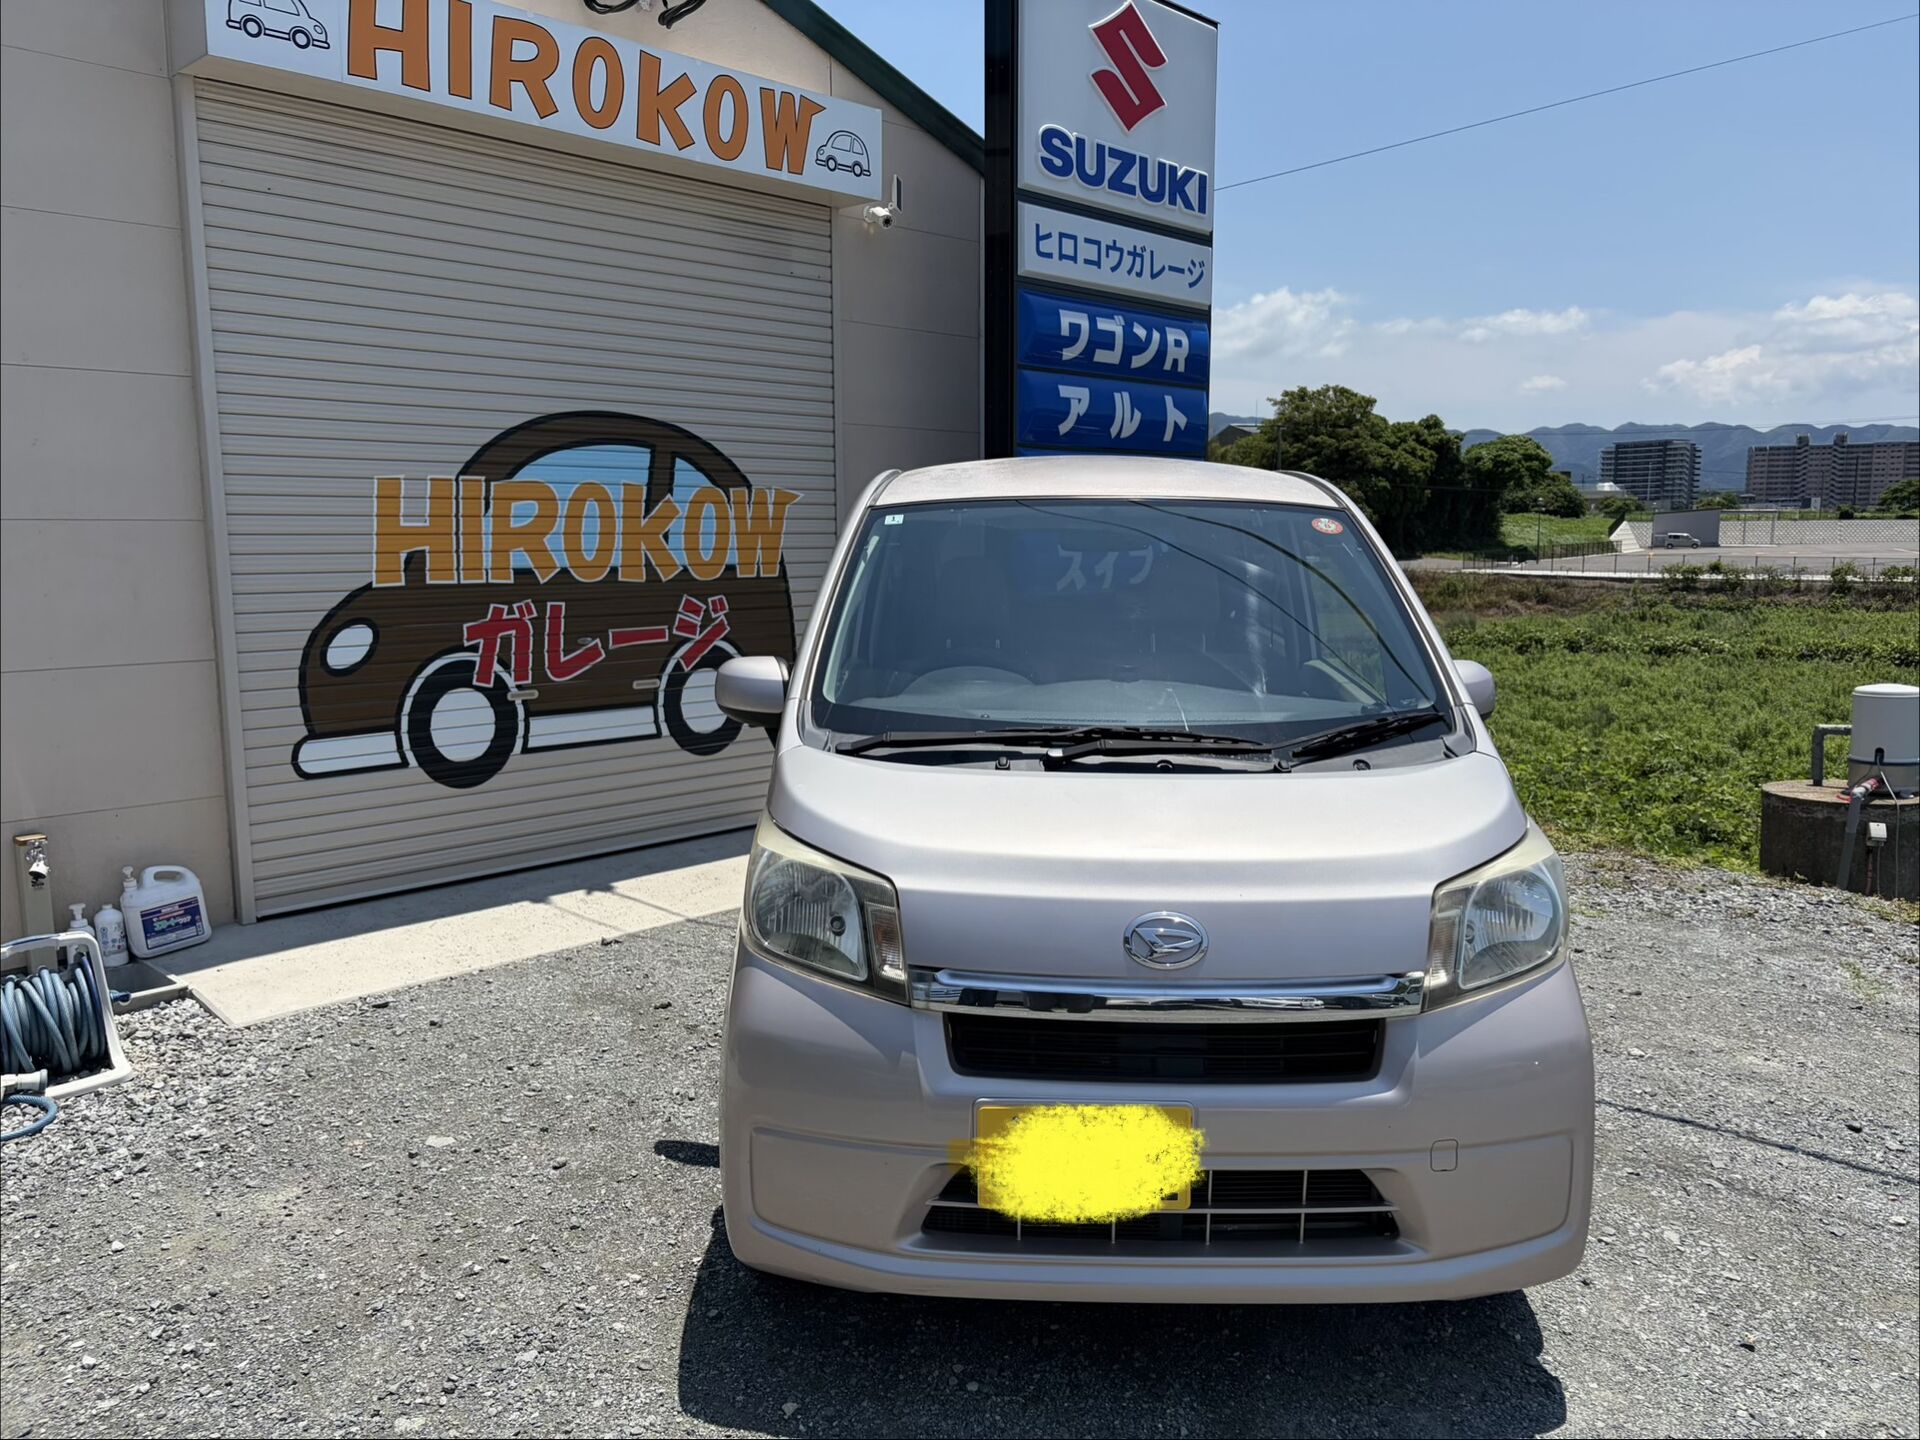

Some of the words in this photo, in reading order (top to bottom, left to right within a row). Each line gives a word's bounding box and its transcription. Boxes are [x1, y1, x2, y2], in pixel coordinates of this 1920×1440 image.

[347, 0, 827, 176] HIROKOW
[1039, 125, 1208, 216] SUZUKI
[1035, 223, 1205, 289] ヒロコウガレージ
[1058, 308, 1190, 373] ワゴンR
[1057, 384, 1188, 442] アルト
[373, 474, 804, 588] HIROKOW
[1056, 543, 1169, 592] スイフ
[463, 594, 731, 689] ガレージ
